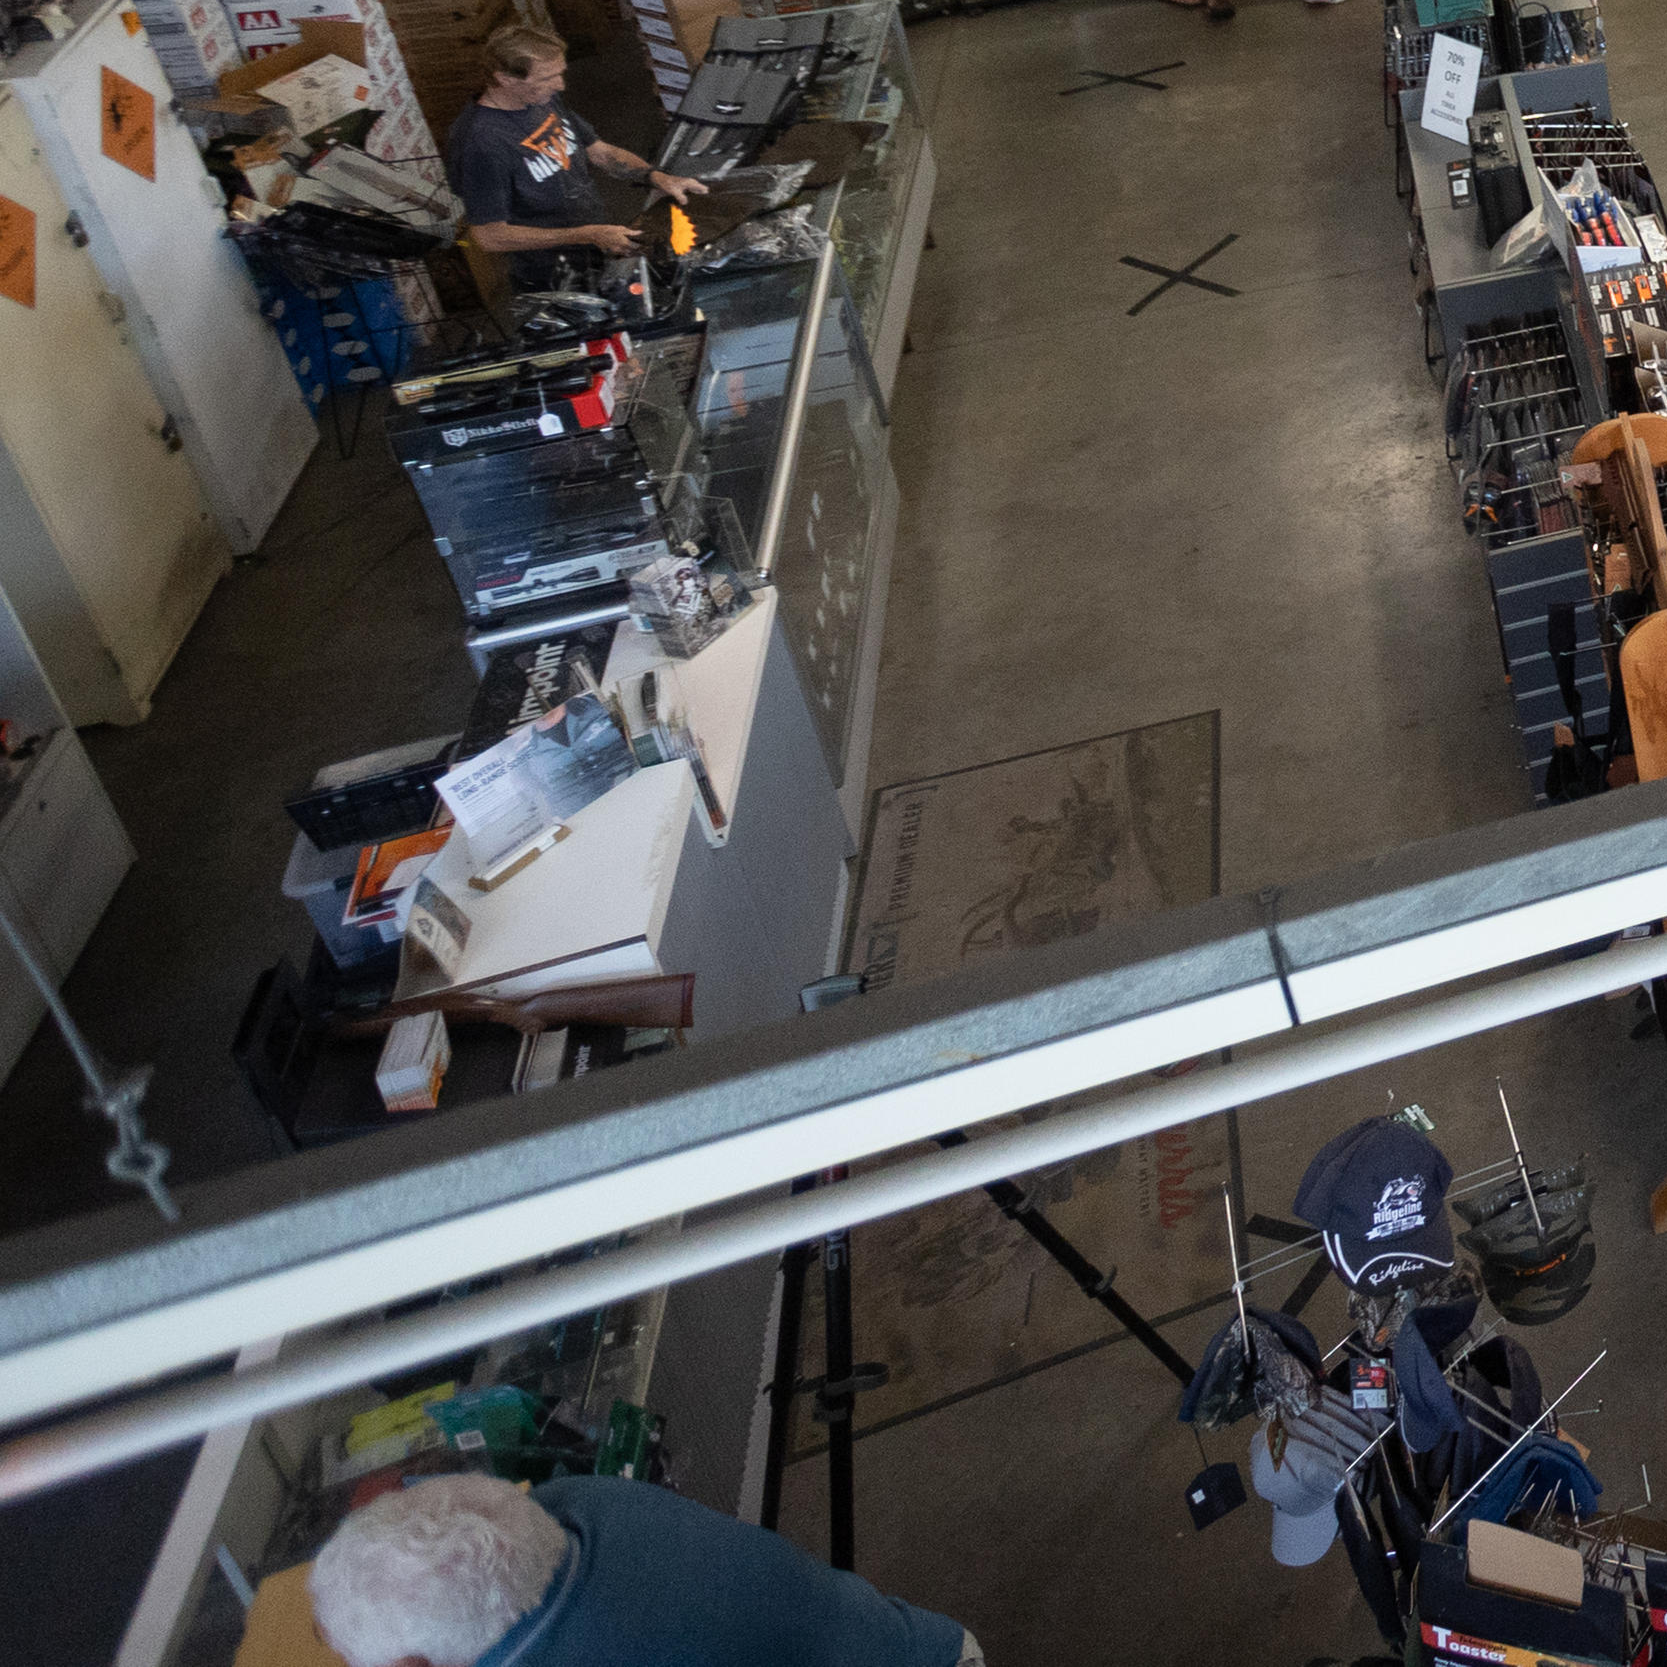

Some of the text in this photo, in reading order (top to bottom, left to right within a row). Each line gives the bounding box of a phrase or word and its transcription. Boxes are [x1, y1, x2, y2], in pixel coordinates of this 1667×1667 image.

[239, 11, 280, 32] AA
[1447, 51, 1465, 68] 70%
[1445, 71, 1462, 85] OFF
[889, 800, 922, 911] PREMIUM DEALER
[1373, 1200, 1423, 1225] Ridgeline
[1369, 1260, 1425, 1287] Ridgeline
[1432, 1625, 1507, 1663] Toaster
